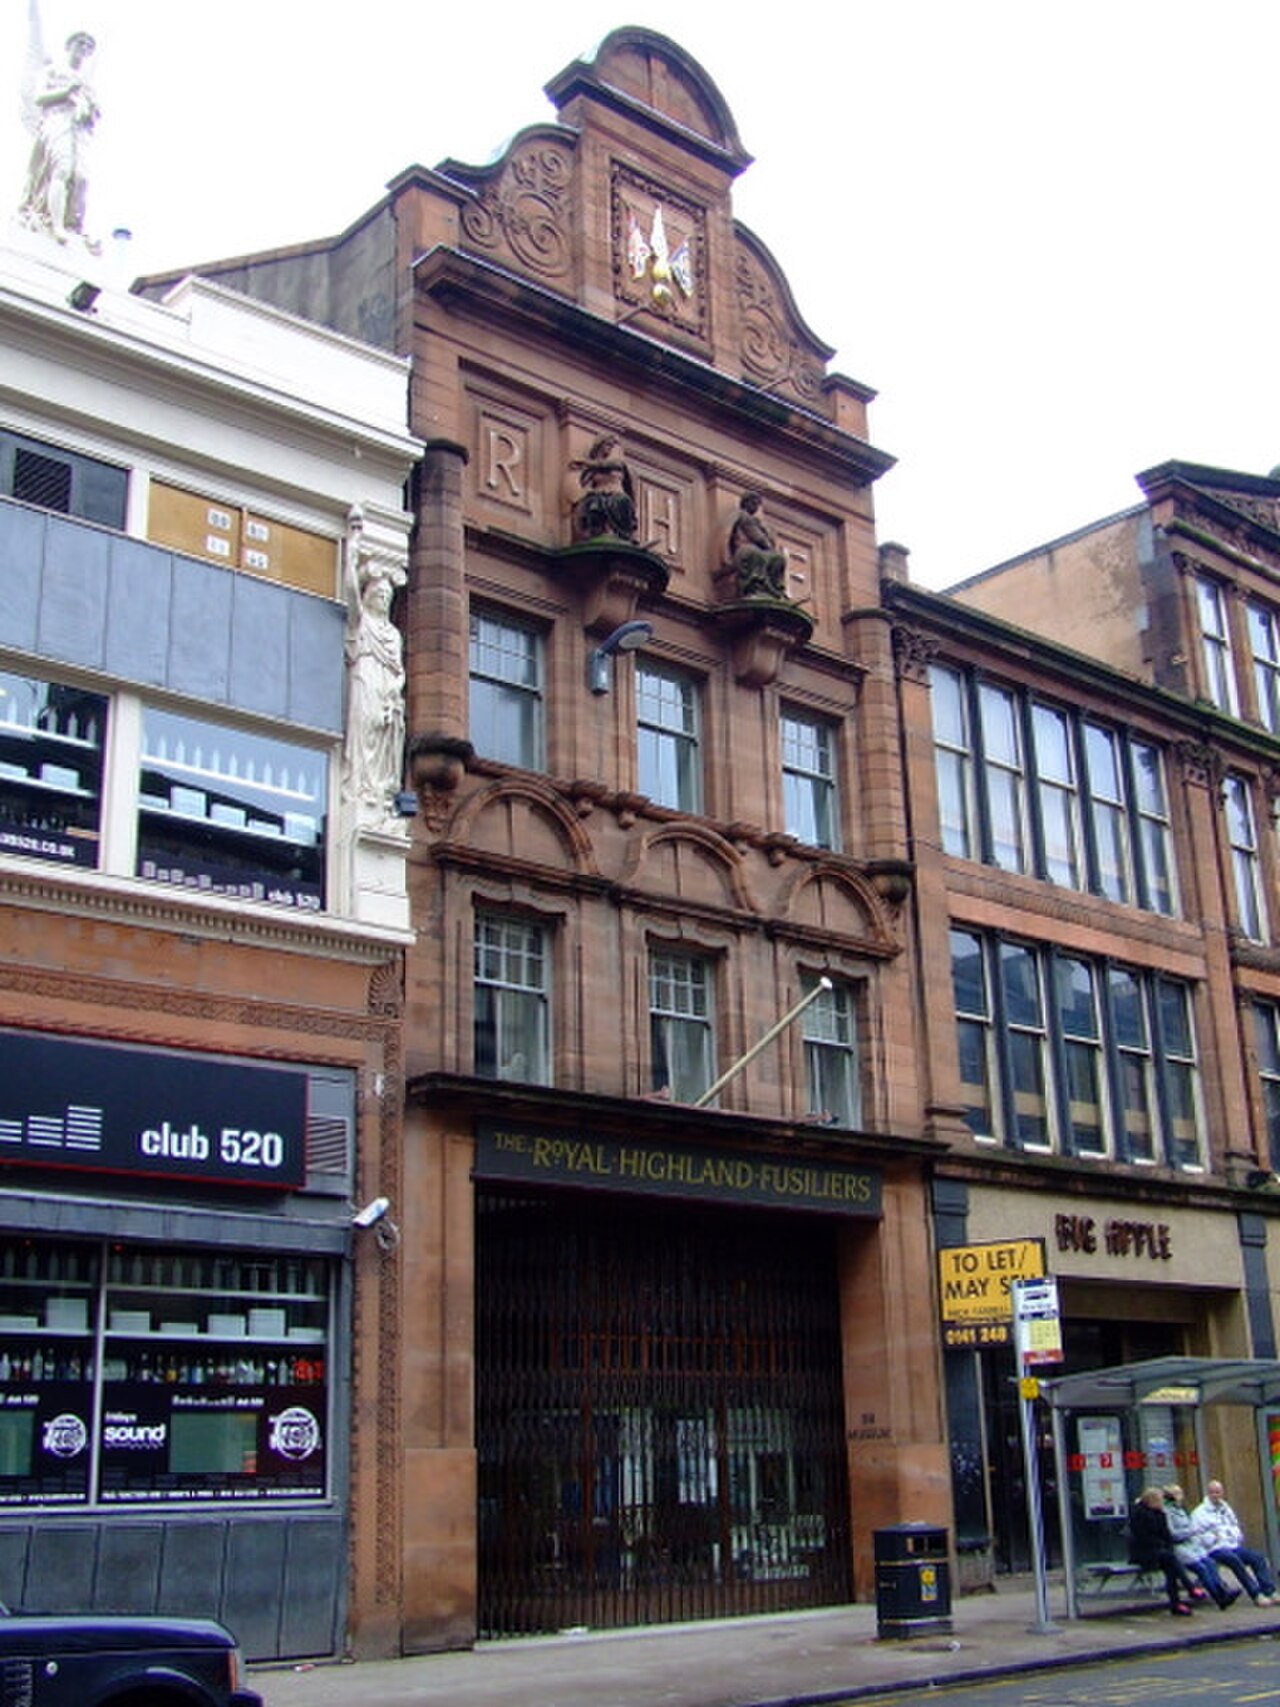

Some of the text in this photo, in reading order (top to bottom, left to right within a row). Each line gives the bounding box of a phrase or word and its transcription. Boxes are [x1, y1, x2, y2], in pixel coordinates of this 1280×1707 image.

[486, 430, 521, 497] R
[141, 1121, 284, 1168] club 520
[494, 1132, 526, 1154] THE
[619, 1147, 754, 1190] HIGHLAND
[759, 1164, 873, 1203] FUSILIERS
[1055, 1213, 1174, 1260] BIG APPLE
[951, 1252, 979, 1274] TO
[944, 1277, 990, 1300] MAY
[103, 1423, 166, 1443] sound
